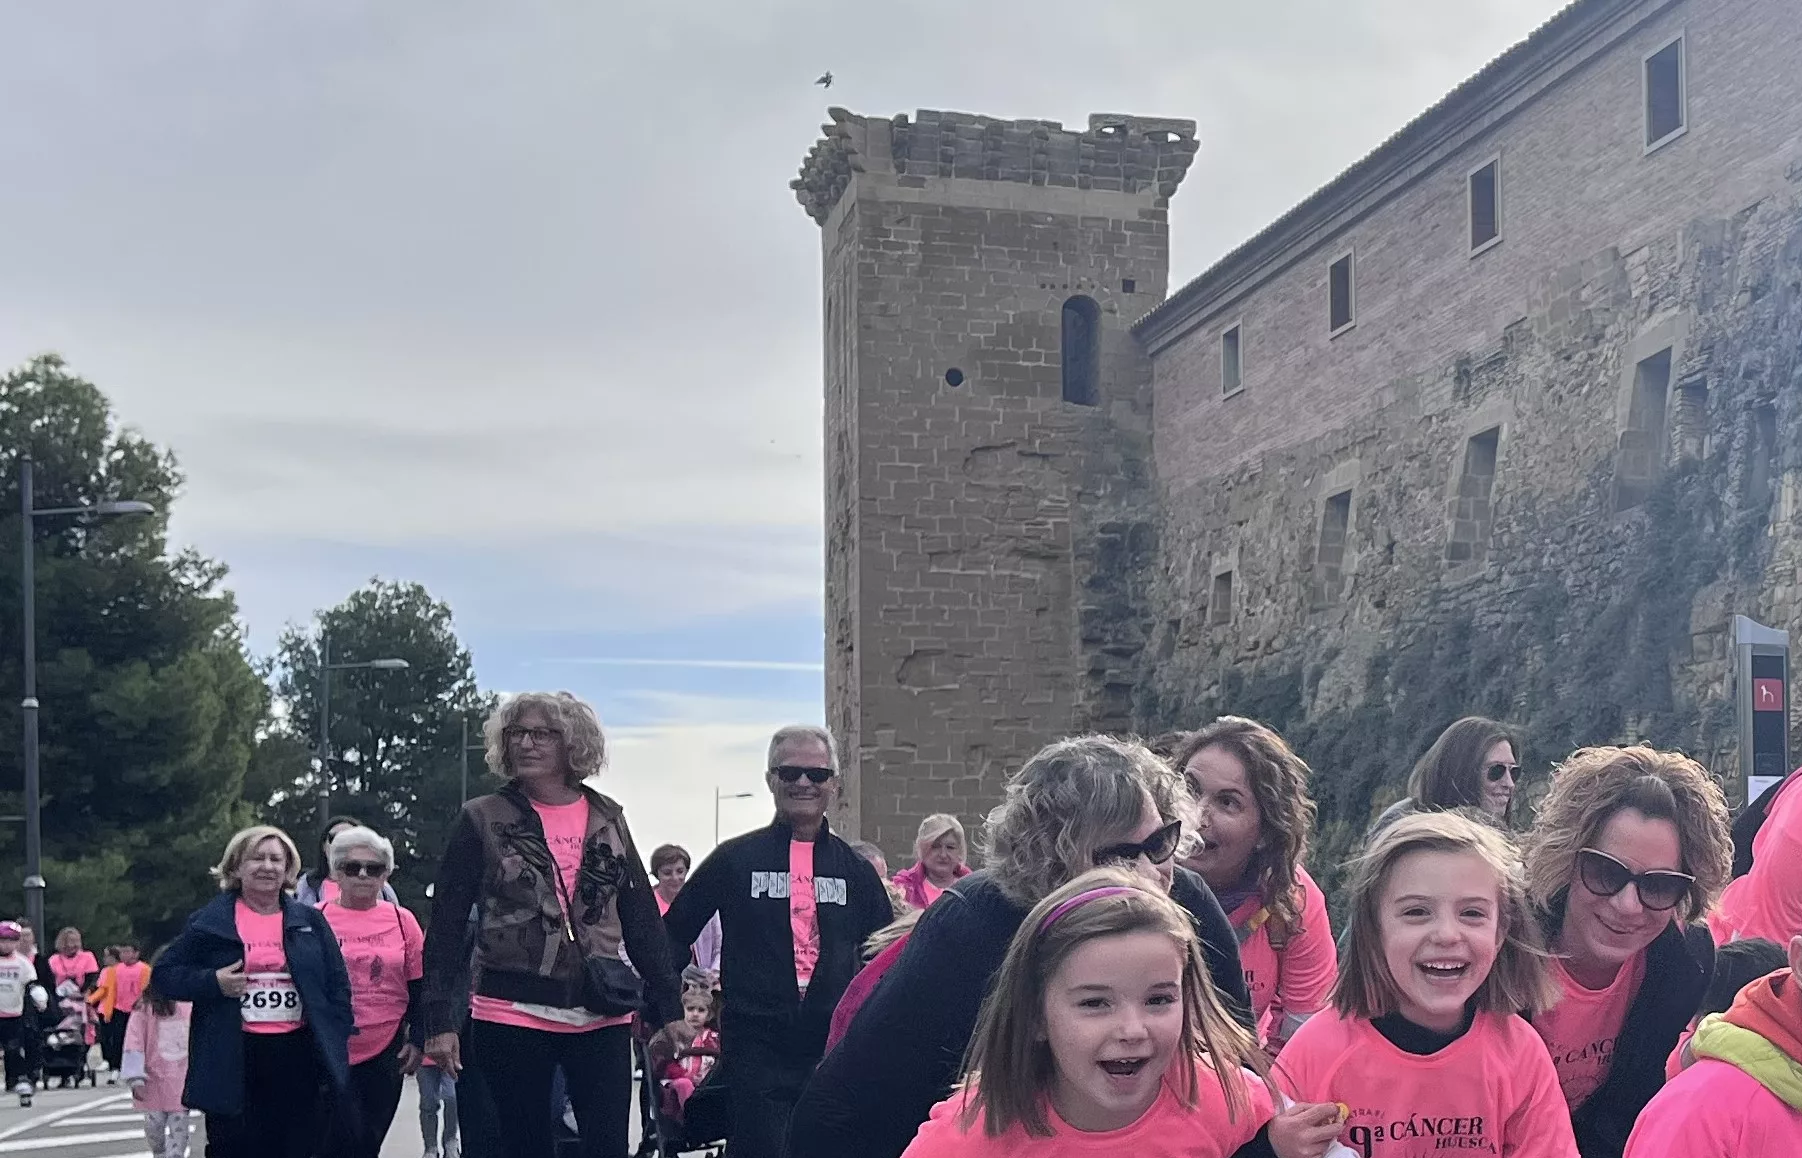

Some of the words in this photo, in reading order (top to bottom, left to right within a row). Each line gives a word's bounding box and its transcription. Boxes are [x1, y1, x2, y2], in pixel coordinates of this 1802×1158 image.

[241, 991, 297, 1009] 2698
[1390, 1113, 1483, 1140] CÁNCER
[1435, 1136, 1497, 1155] HUESCA
